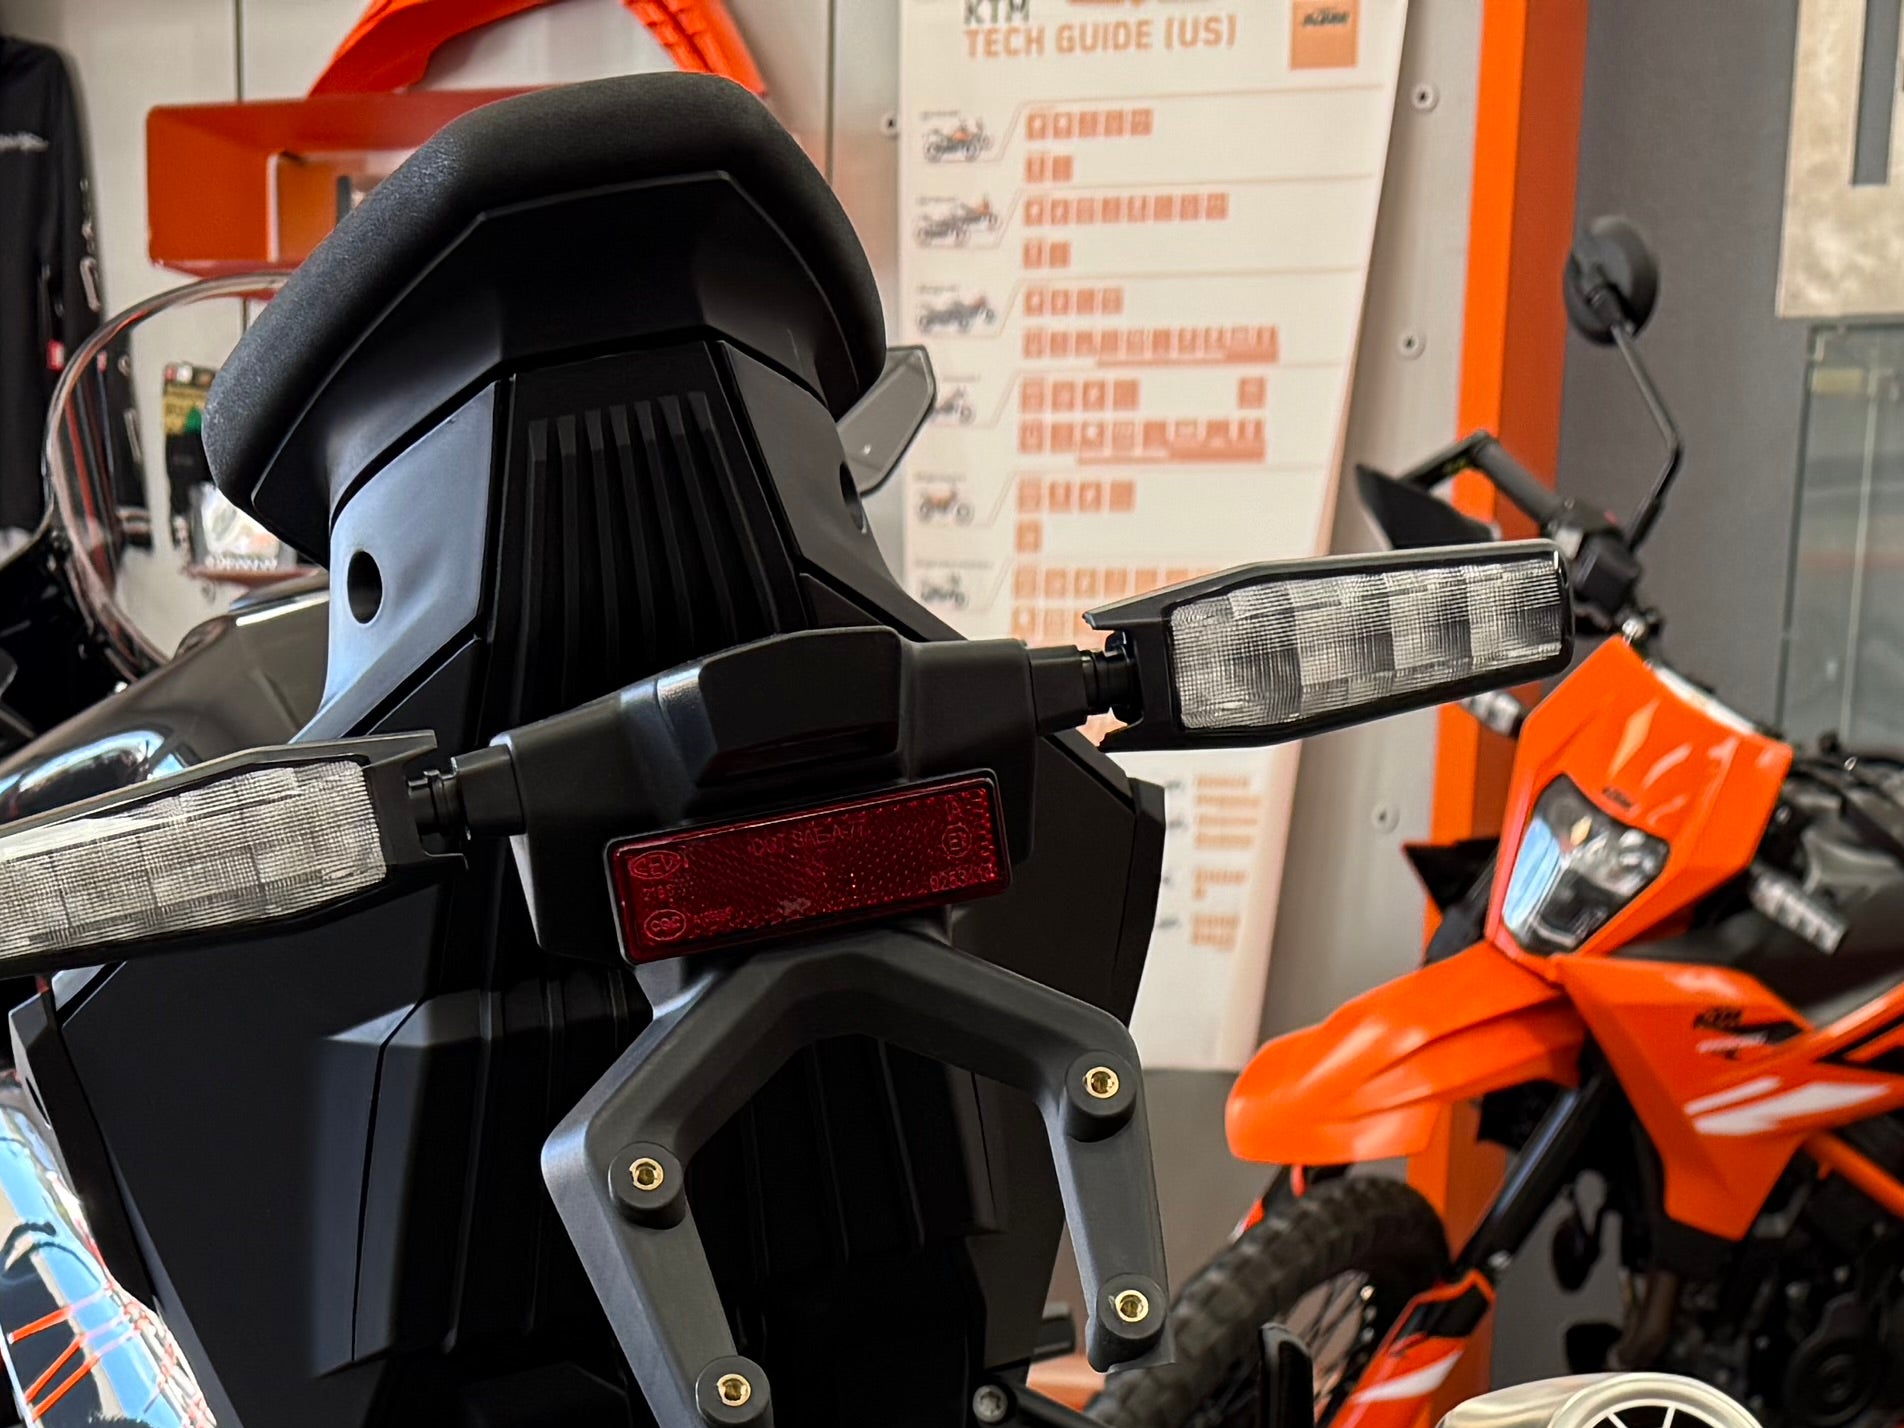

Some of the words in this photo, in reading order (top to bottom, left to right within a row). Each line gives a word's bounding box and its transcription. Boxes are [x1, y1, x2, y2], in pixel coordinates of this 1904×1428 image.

[964, 0, 1030, 25] KTM
[964, 27, 1045, 58] TECH
[1056, 18, 1153, 54] GUIDE
